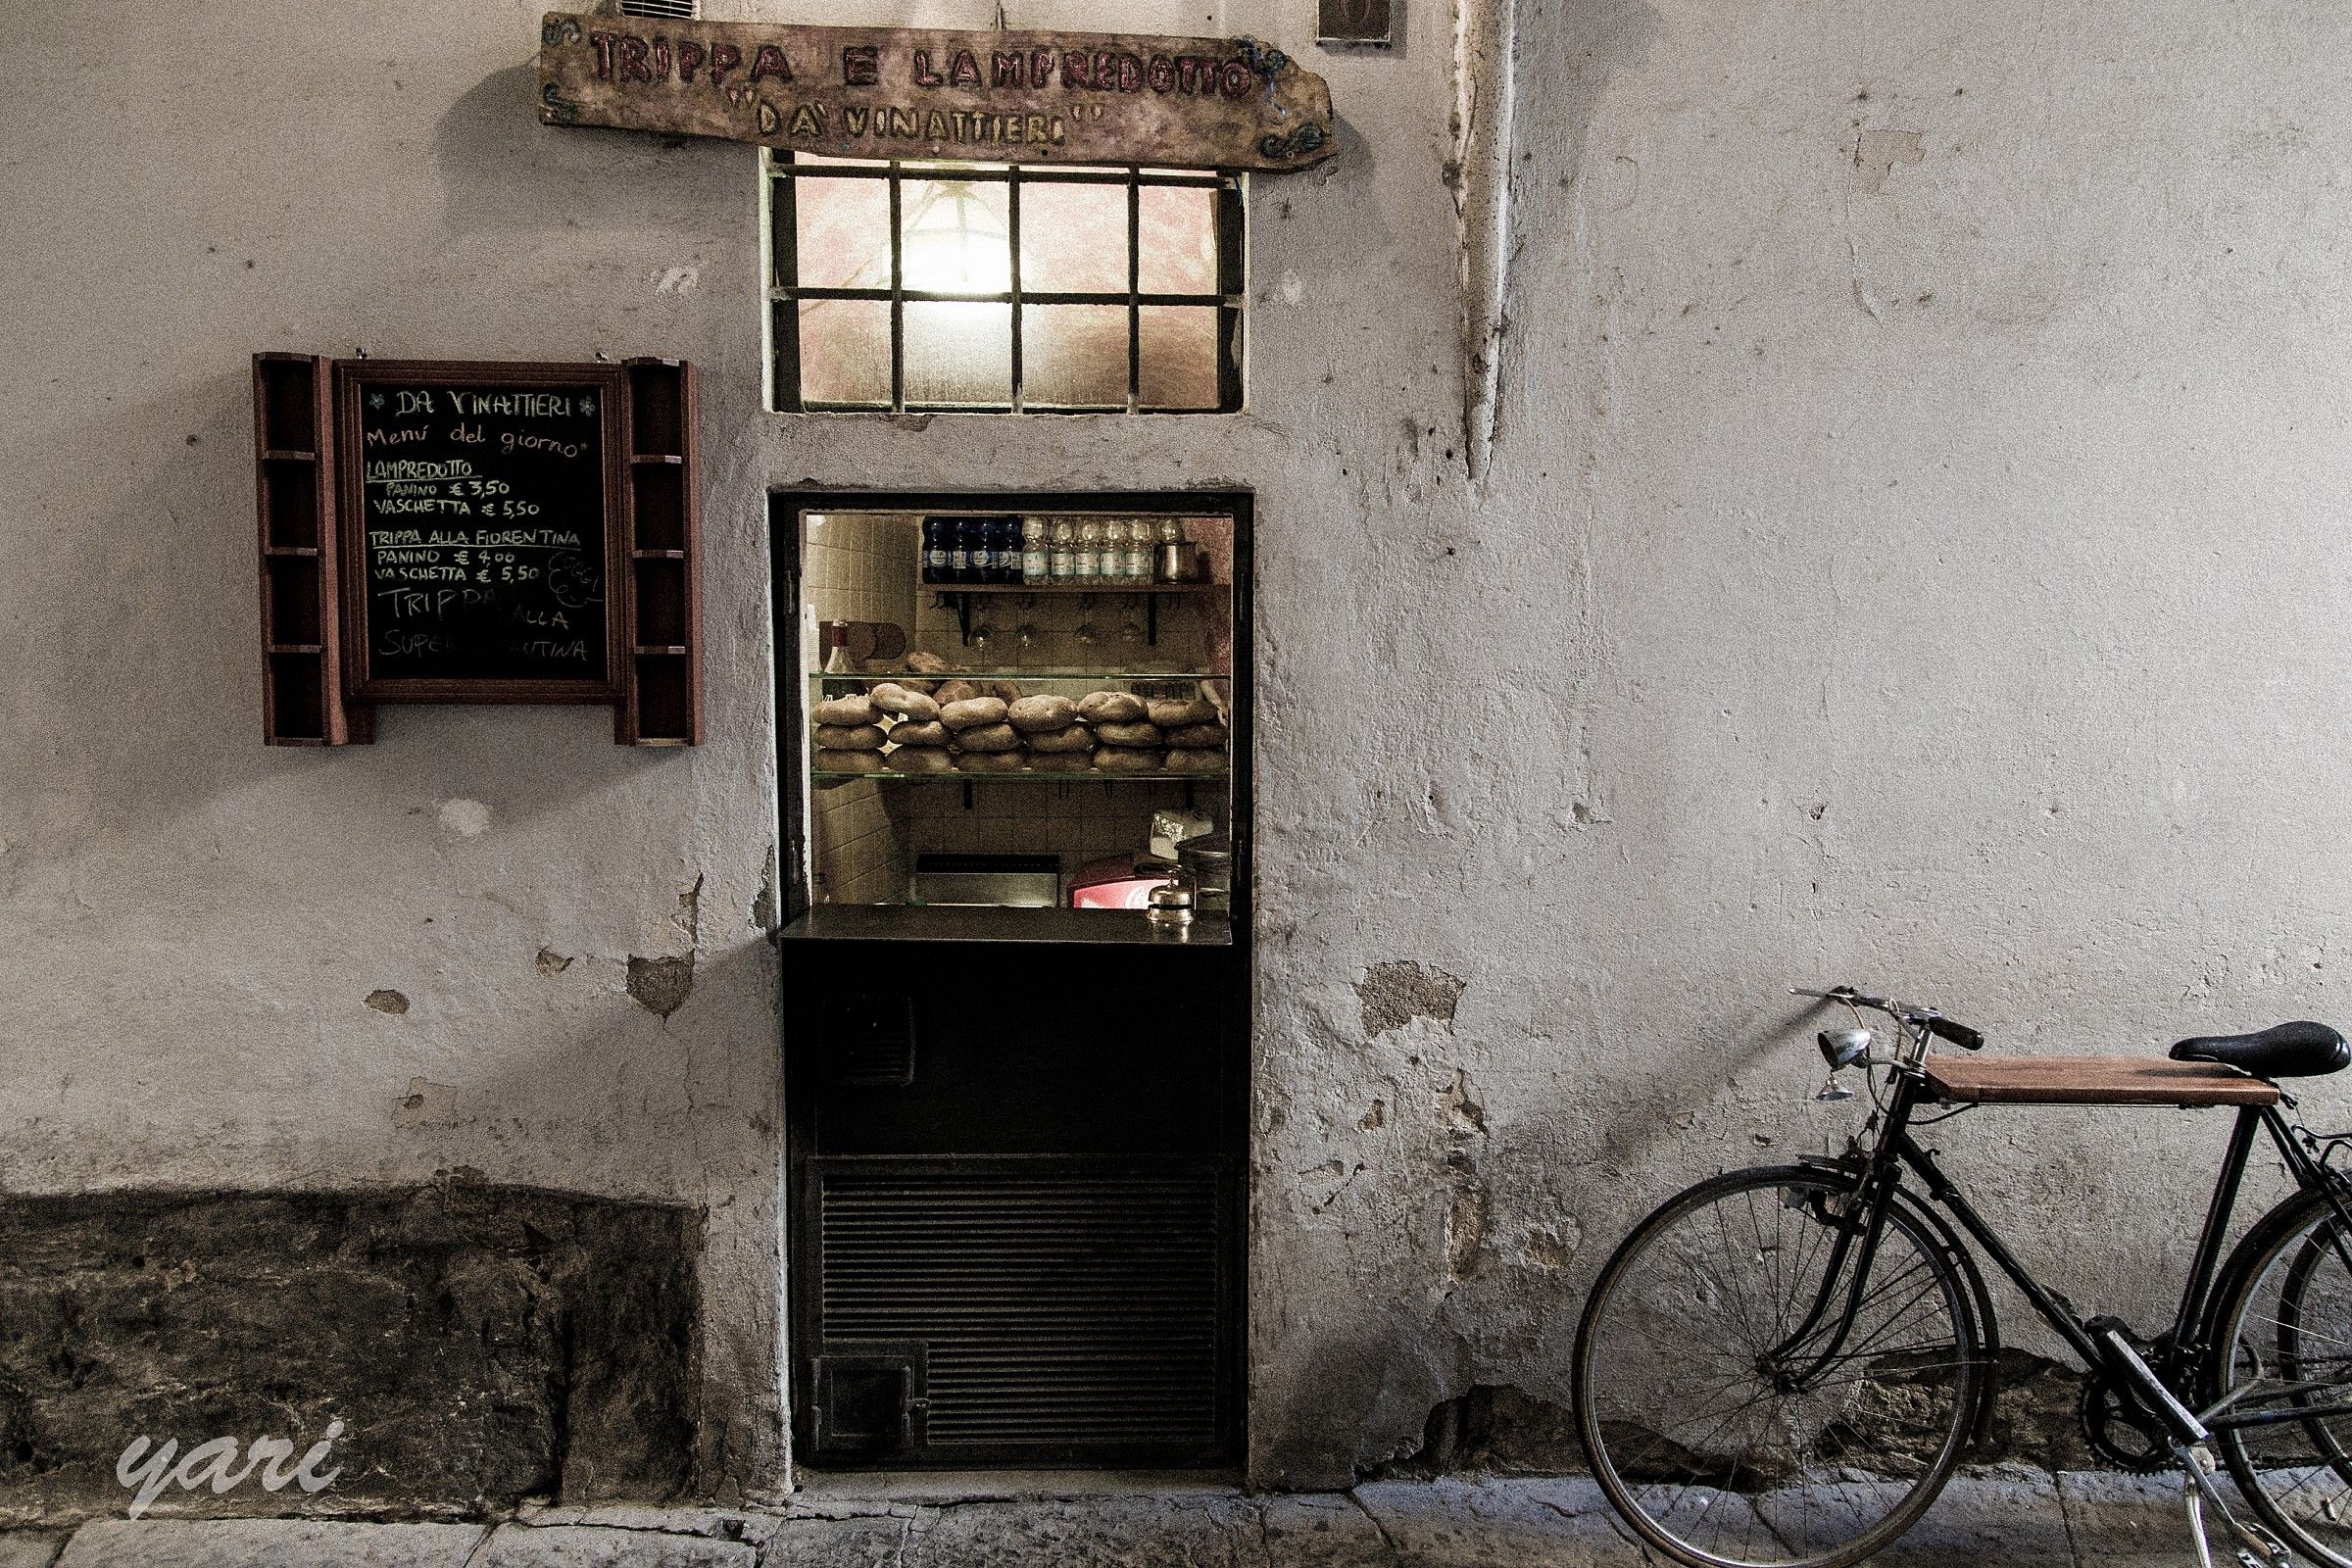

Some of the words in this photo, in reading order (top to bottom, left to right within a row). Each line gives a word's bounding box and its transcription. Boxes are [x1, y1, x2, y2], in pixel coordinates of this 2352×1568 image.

[591, 30, 792, 85] TRIPPA
[843, 45, 878, 86] E
[395, 390, 435, 416] DA
[447, 390, 571, 416] VINATTIERI
[450, 421, 486, 444] del
[385, 482, 438, 498] PANINO
[449, 481, 465, 497] €
[470, 479, 511, 500] 3,50
[372, 499, 471, 516] VASCHETTA
[480, 502, 496, 517] €
[503, 500, 540, 519] 5,50
[368, 529, 421, 547] TRIPPA
[428, 529, 469, 546] ALLA
[475, 529, 581, 546] FIORENTINA
[377, 550, 441, 564] PANINO
[453, 549, 469, 565] €
[374, 565, 468, 582] VASCHETTA
[475, 568, 492, 584] €
[501, 564, 540, 584] 5,50
